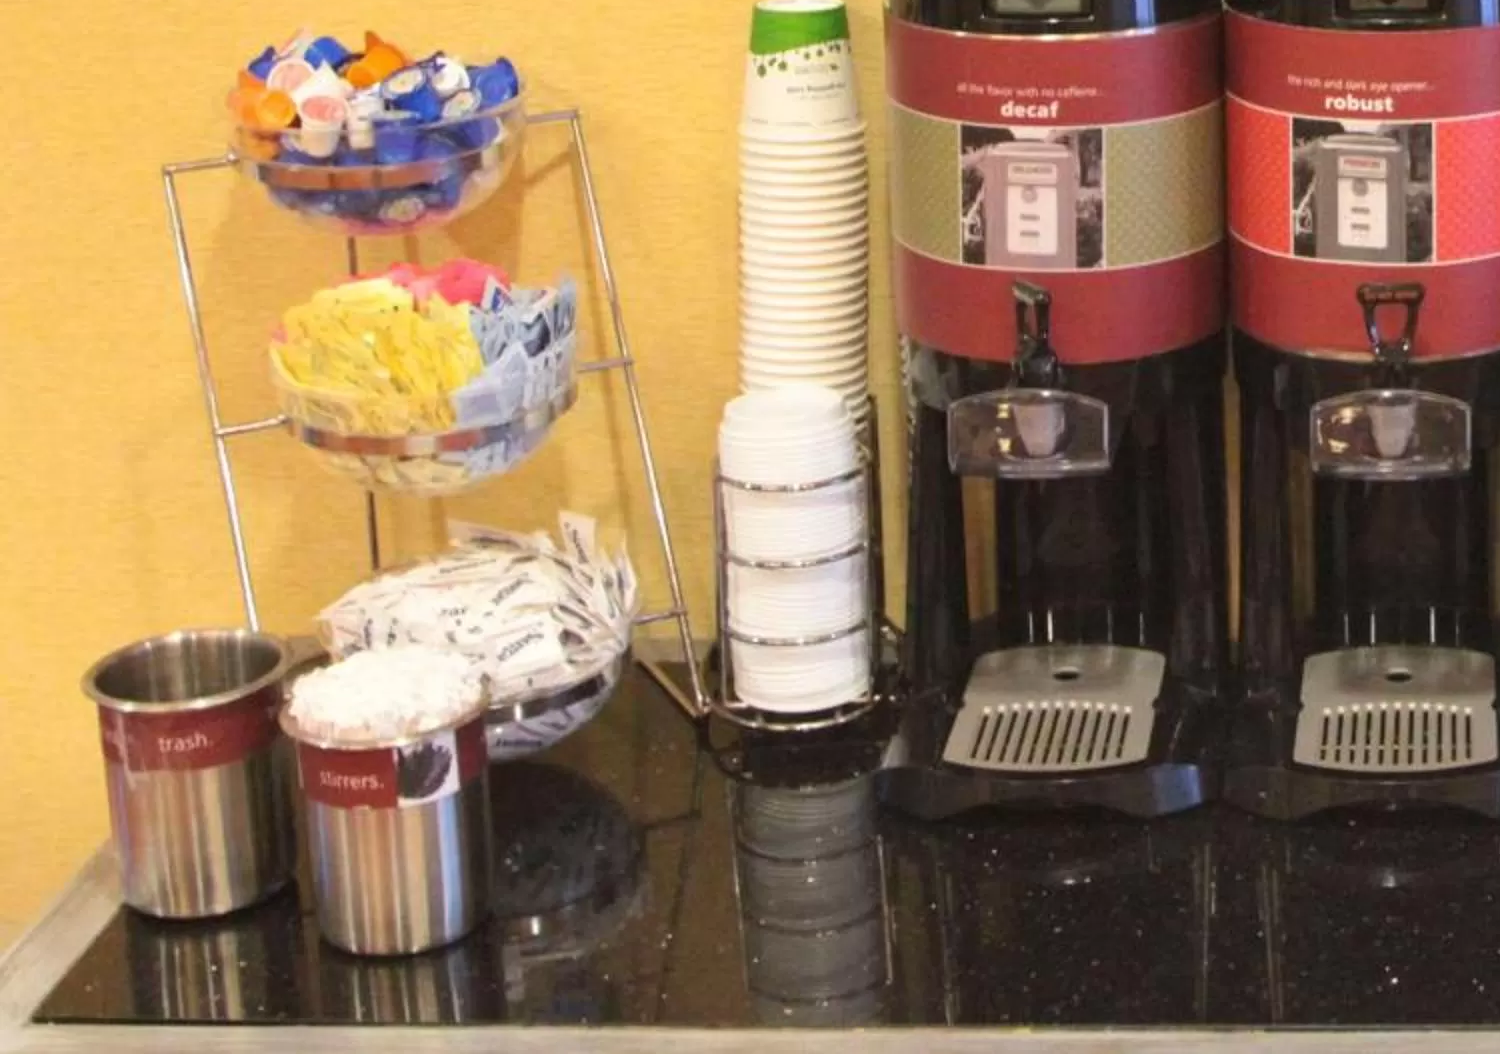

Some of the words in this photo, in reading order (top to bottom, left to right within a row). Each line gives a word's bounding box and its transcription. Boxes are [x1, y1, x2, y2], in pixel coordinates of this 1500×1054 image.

[1000, 99, 1060, 119] decaf
[1324, 93, 1395, 113] robust
[158, 732, 213, 753] trash.
[319, 770, 385, 791] stirrers.
